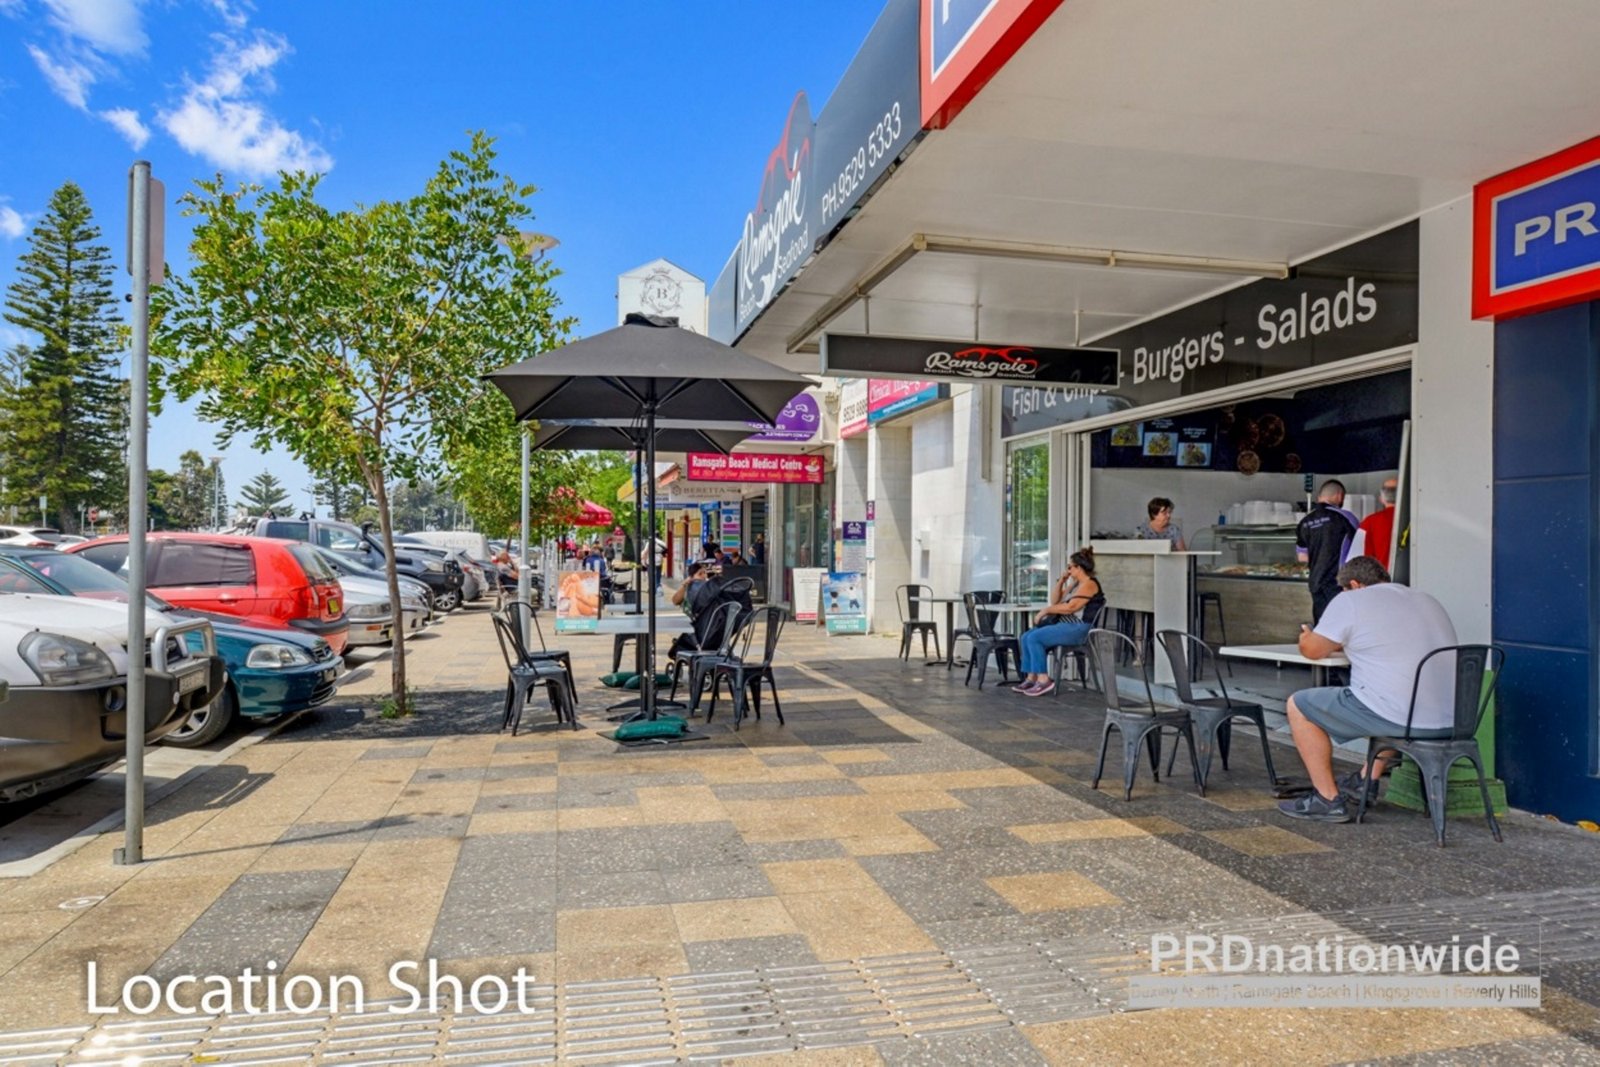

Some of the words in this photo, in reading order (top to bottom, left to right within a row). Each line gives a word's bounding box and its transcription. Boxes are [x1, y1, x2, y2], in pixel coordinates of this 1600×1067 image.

[822, 147, 865, 225] PH.9529
[869, 101, 902, 168] 5333
[776, 222, 809, 279] Seafood
[926, 351, 1036, 378] Ramsgate
[1012, 386, 1040, 417] Fish
[1044, 387, 1057, 408] &
[1133, 329, 1225, 385] Burgers
[1256, 276, 1378, 350] Salads
[692, 455, 726, 470] Ramsgate
[729, 456, 750, 468] Beach
[752, 457, 778, 469] Medical
[780, 458, 802, 470] Centre
